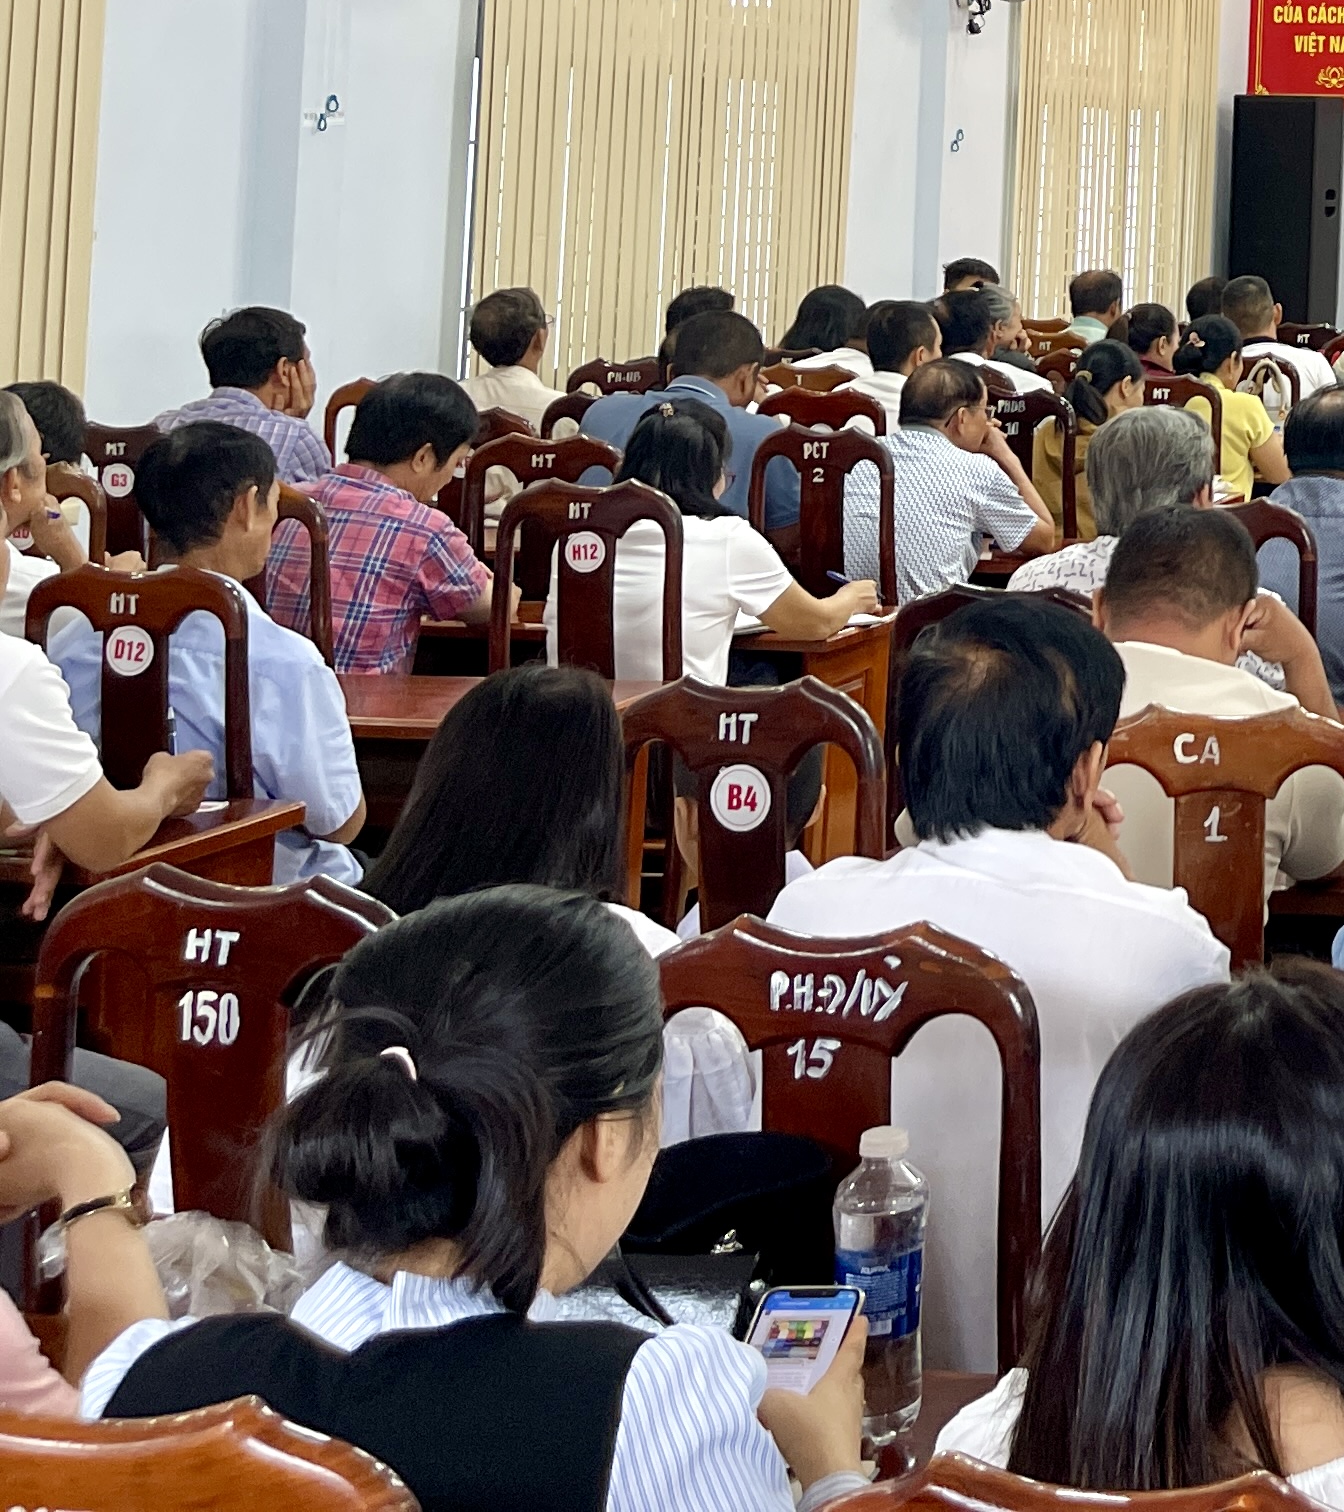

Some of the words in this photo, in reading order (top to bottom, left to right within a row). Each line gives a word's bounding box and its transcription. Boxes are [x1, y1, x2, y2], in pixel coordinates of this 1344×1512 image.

[1273, 0, 1303, 23] CỦA
[1294, 31, 1326, 56] VIỆT
[1152, 388, 1170, 399] HT
[105, 443, 126, 456] HT
[803, 442, 829, 460] PCT
[531, 455, 555, 468] HT
[111, 474, 127, 487] G3
[812, 468, 825, 482] 2
[567, 502, 592, 520] HT
[572, 544, 599, 561] H12
[110, 592, 139, 616] HT
[115, 639, 146, 662] D12
[718, 712, 759, 744] HT
[1173, 733, 1219, 765] CA
[727, 785, 758, 811] B4
[1204, 806, 1228, 843] 1
[184, 928, 240, 966] HT
[178, 990, 241, 1046] 150
[787, 1037, 841, 1080] 15
